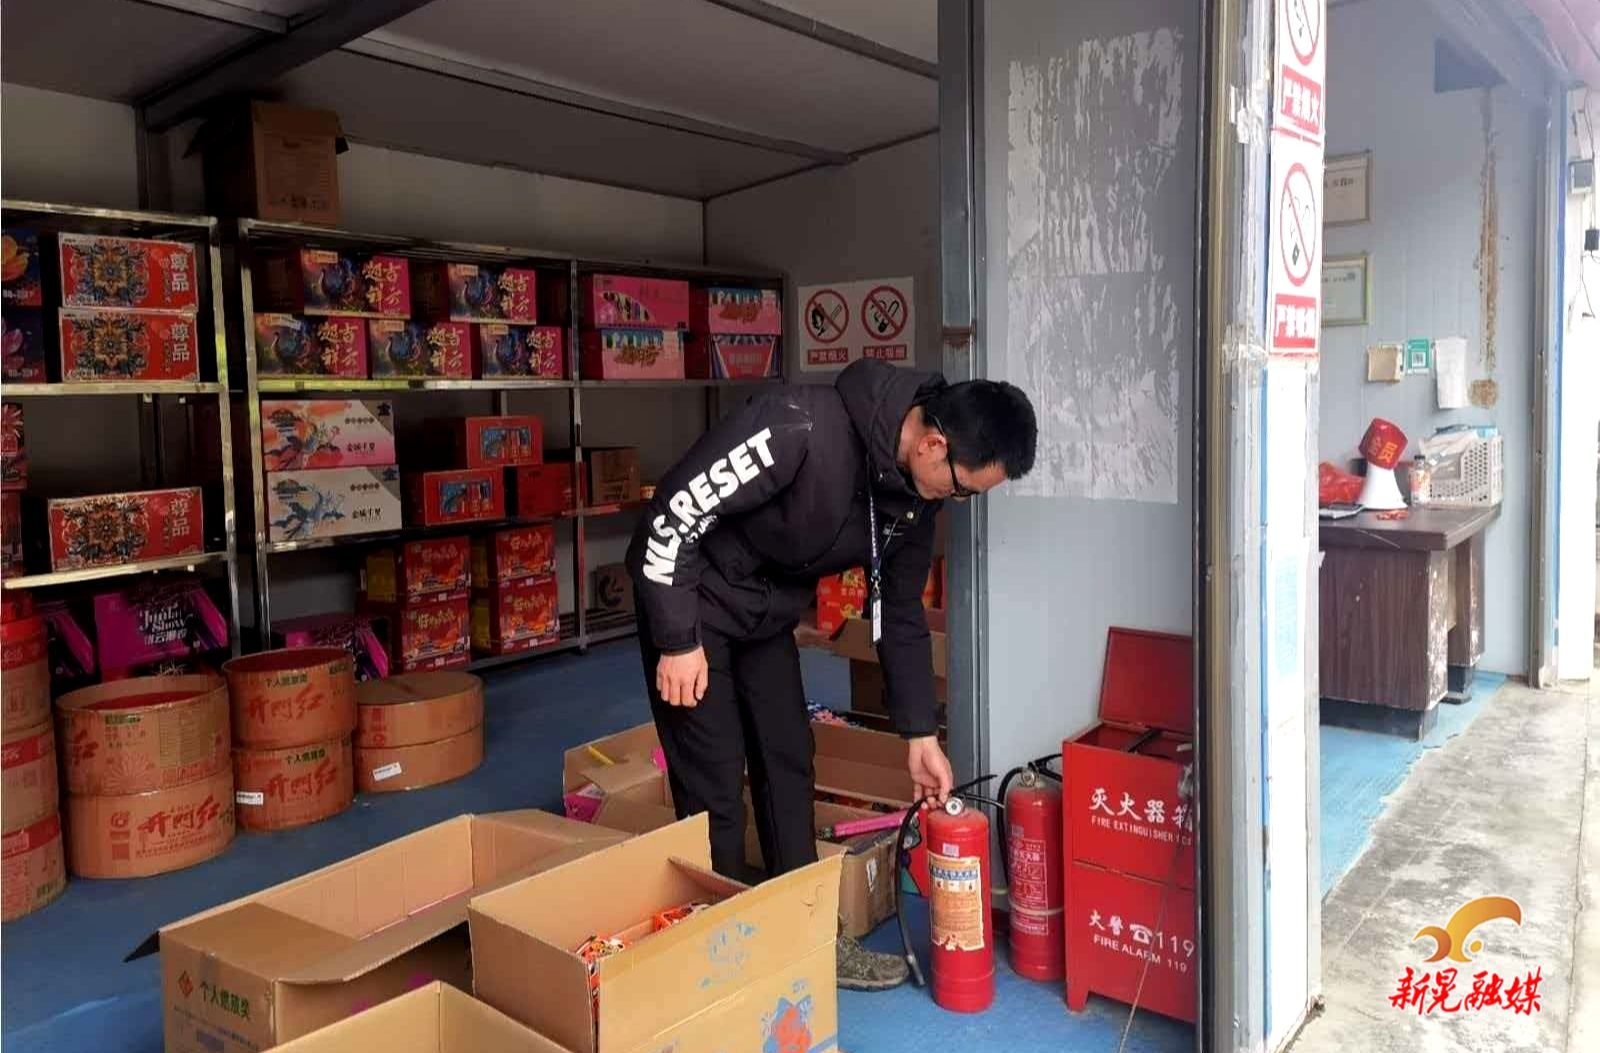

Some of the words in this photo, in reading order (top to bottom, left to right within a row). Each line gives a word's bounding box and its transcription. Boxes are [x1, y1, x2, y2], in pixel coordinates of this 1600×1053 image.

[643, 427, 775, 585] NLS.RESET
[1091, 815, 1110, 828] FIRE
[1113, 820, 1174, 842] EXTINGUISHER
[1089, 909, 1123, 936] 火警
[1156, 931, 1194, 958] 119
[1093, 934, 1119, 951] FIRE
[1122, 944, 1161, 965] ALARM
[1167, 959, 1187, 973] 119
